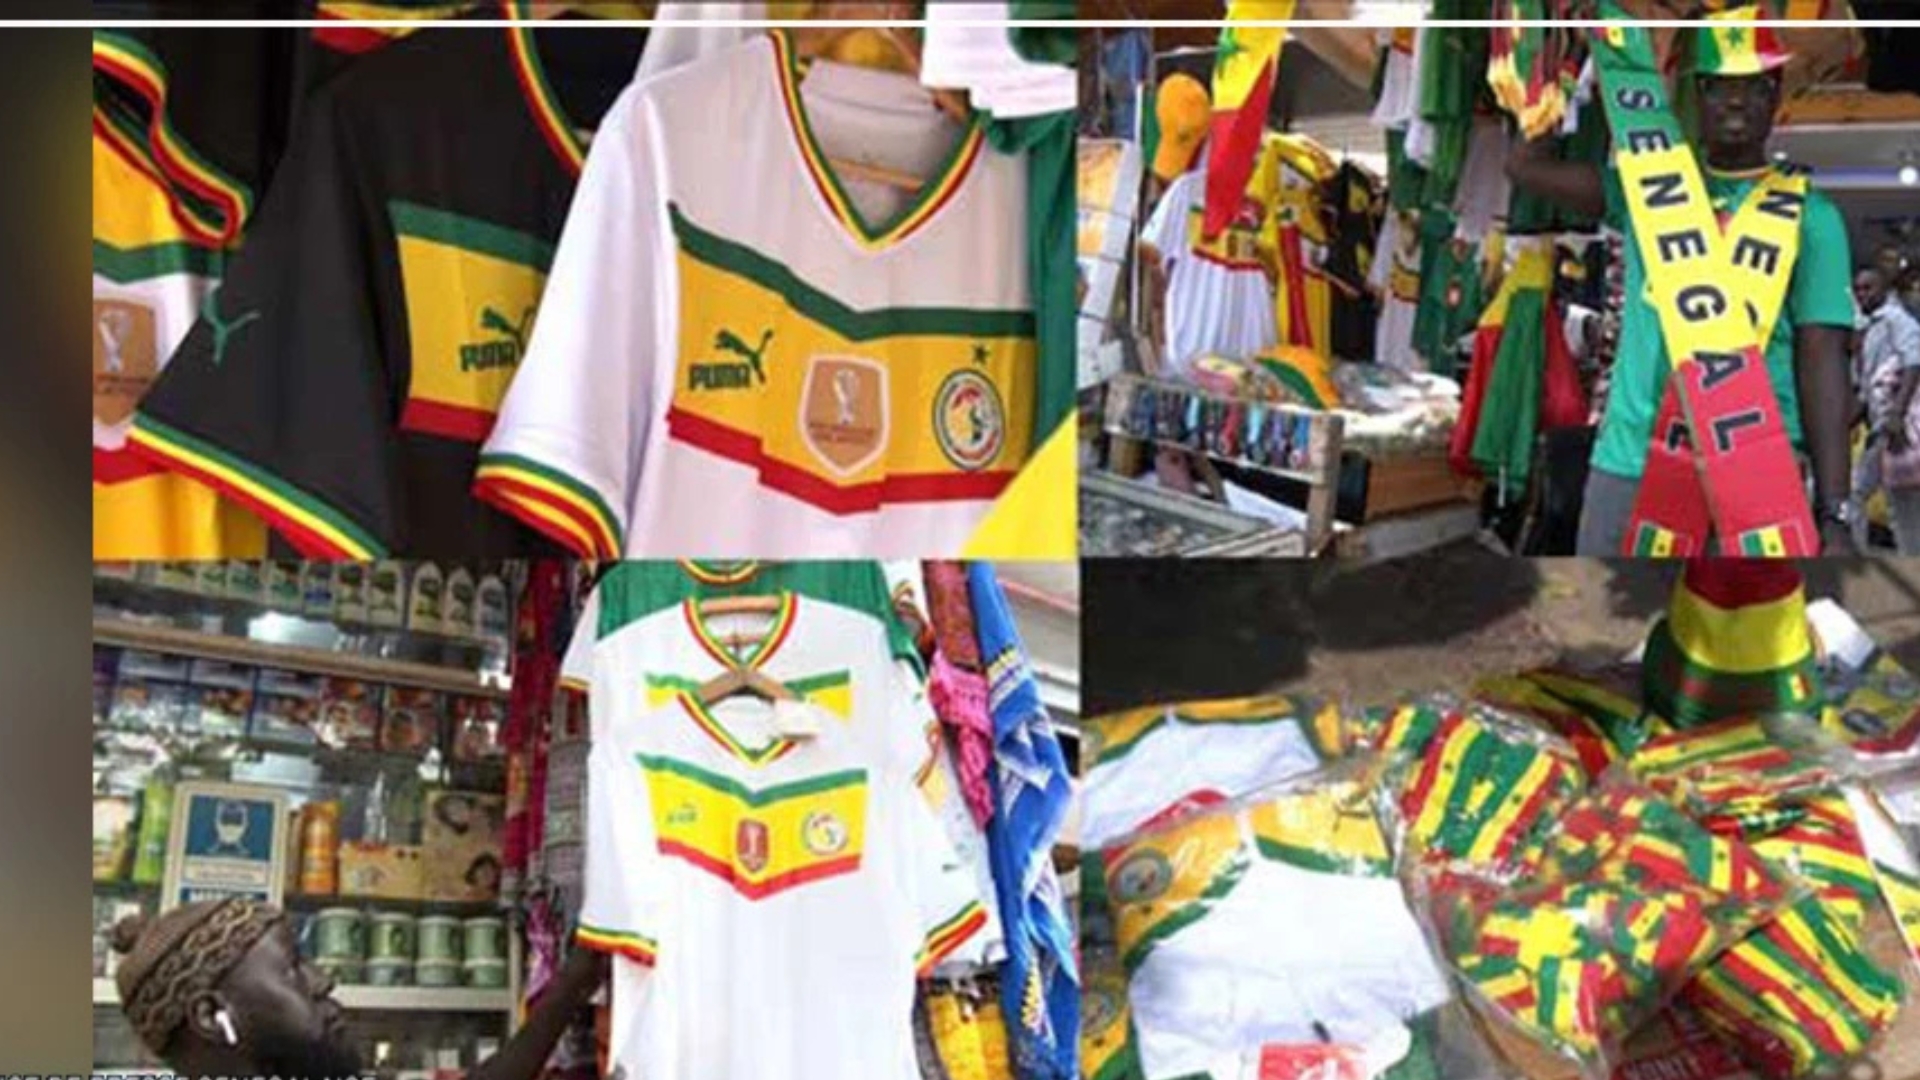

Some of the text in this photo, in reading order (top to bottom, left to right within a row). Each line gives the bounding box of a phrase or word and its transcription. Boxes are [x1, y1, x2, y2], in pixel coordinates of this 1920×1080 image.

[1616, 87, 1764, 451] SENEGAL
[460, 341, 516, 371] PUMA
[689, 362, 750, 391] PUMA
